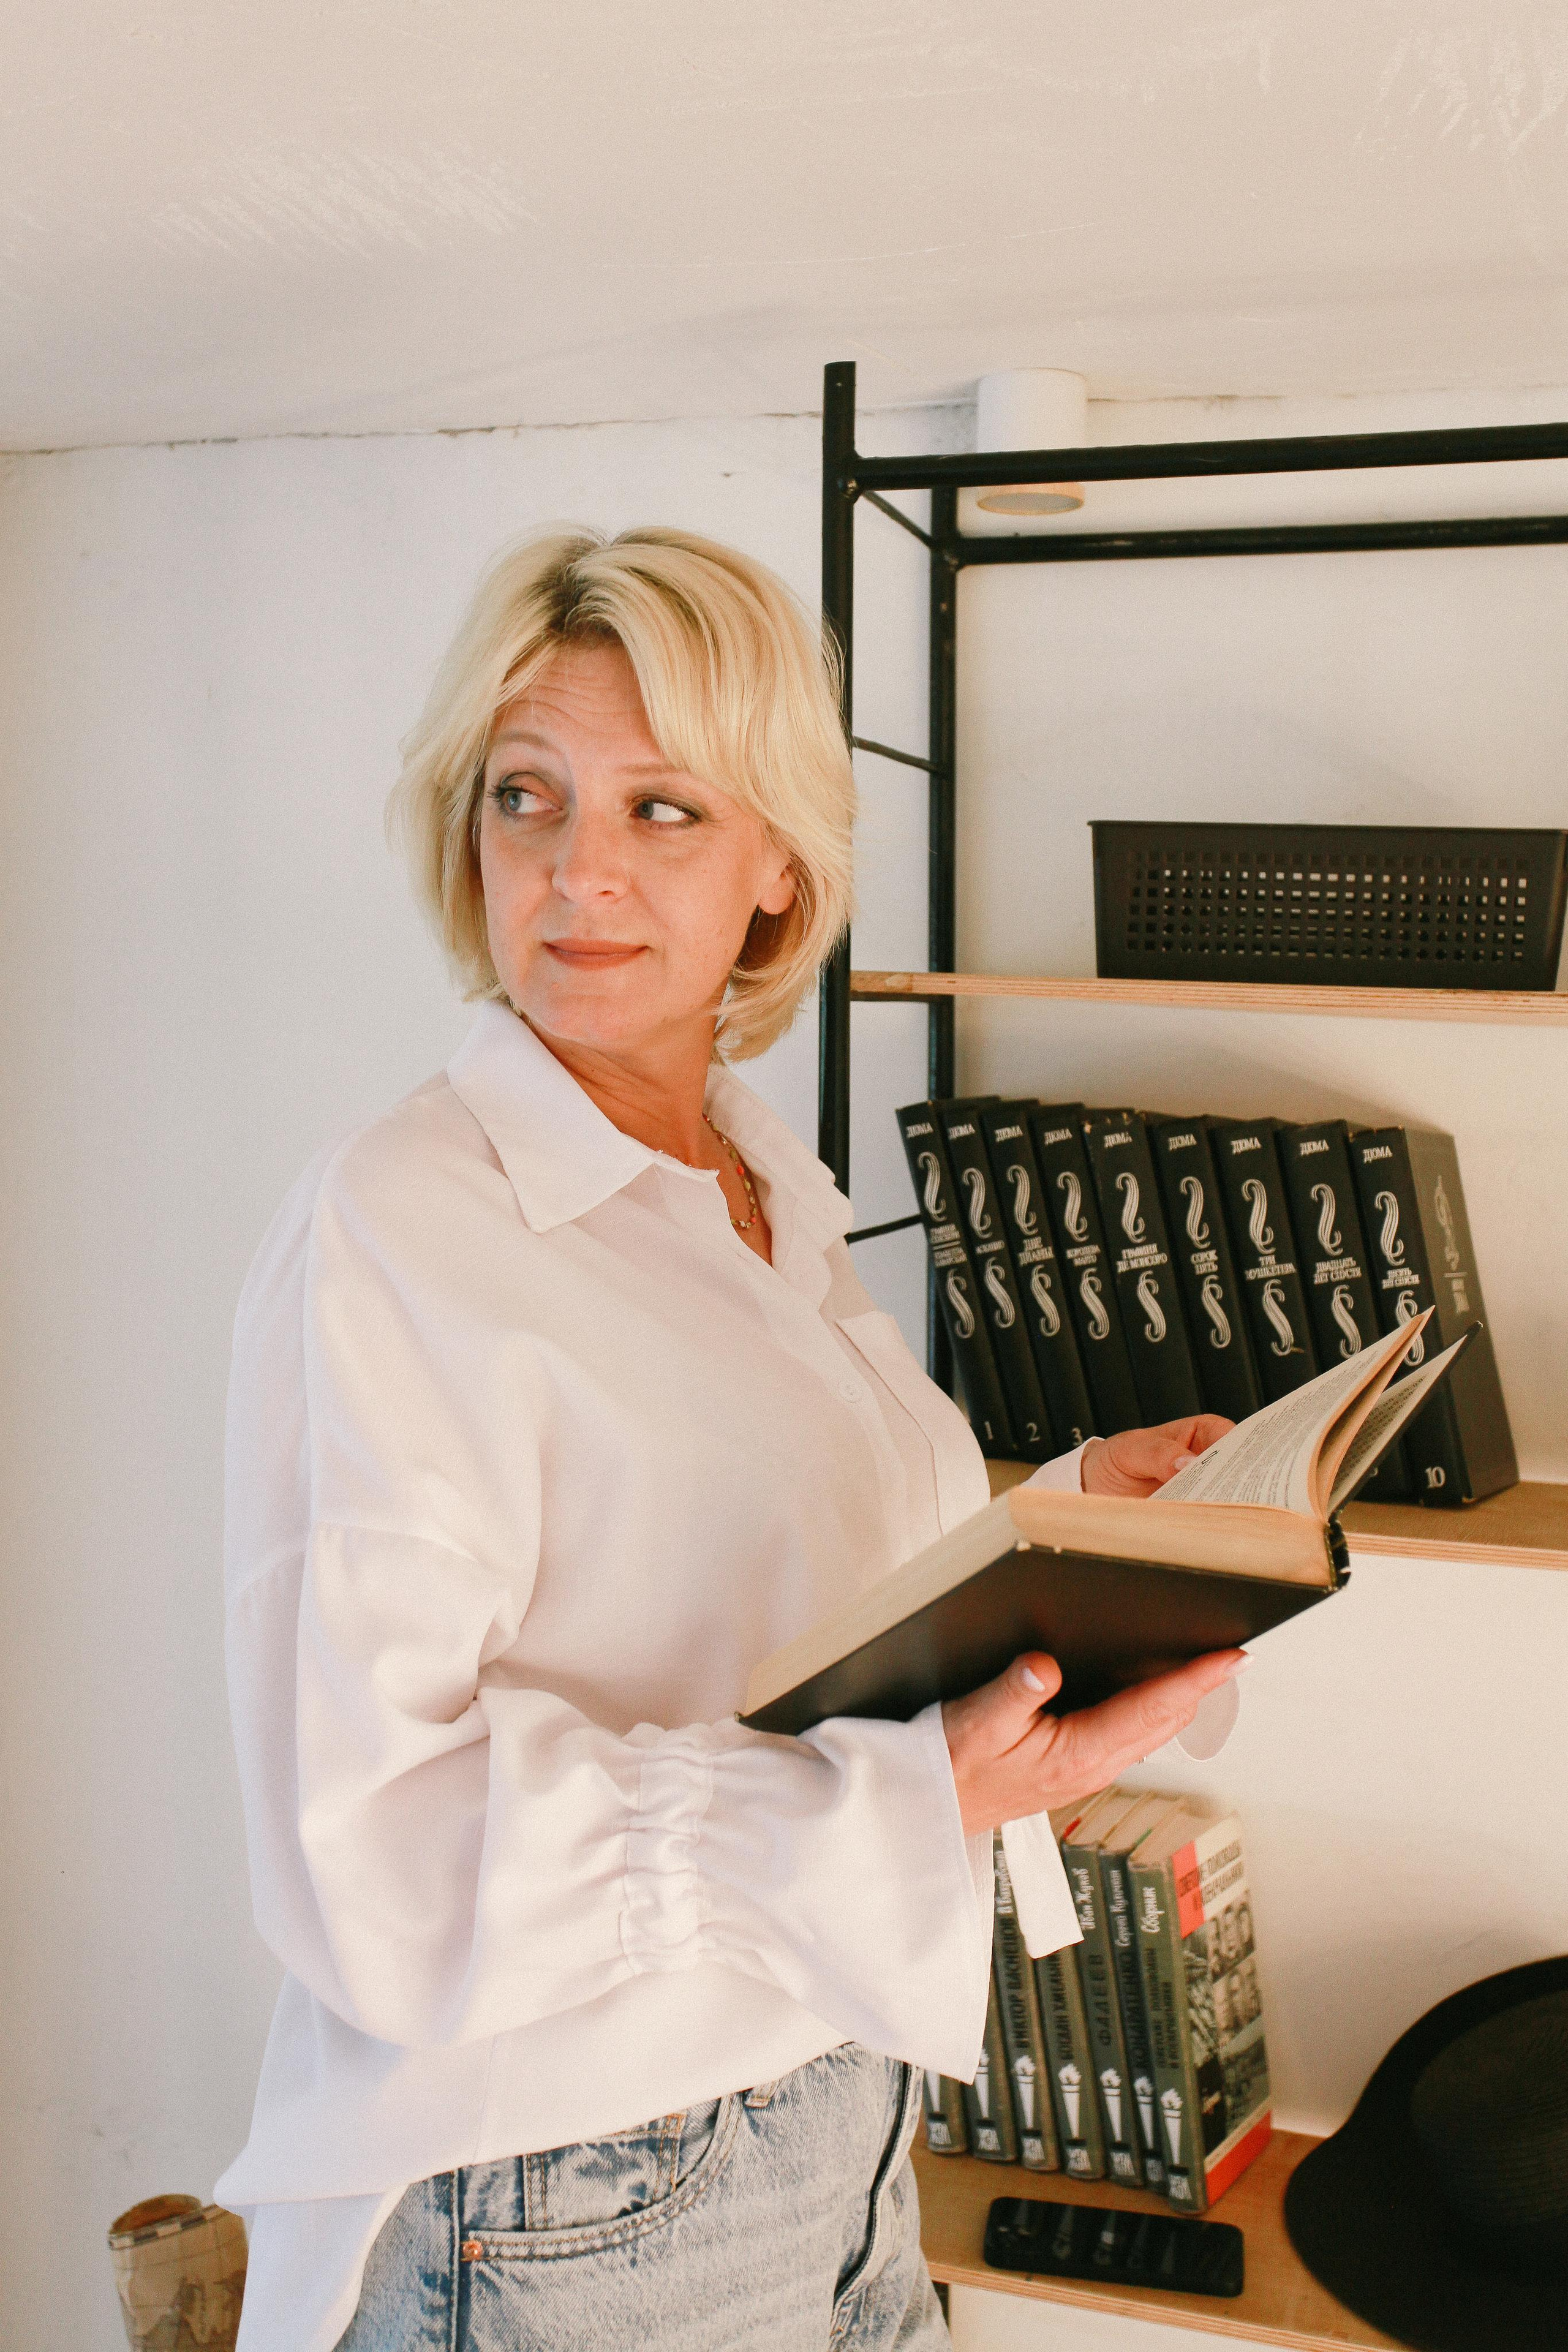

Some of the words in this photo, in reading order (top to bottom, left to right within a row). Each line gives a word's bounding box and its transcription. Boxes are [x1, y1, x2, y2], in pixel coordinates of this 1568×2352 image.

[984, 1421, 993, 1440] 1
[1027, 1422, 1041, 1442] 2
[1072, 1427, 1084, 1447] 3
[1426, 1466, 1446, 1488] 10
[998, 1917, 1022, 1991] ВАСНЕЦОВ
[1088, 1954, 1112, 2045] ФАДЕЕВ
[1009, 1993, 1029, 2049] ВИКТОР
